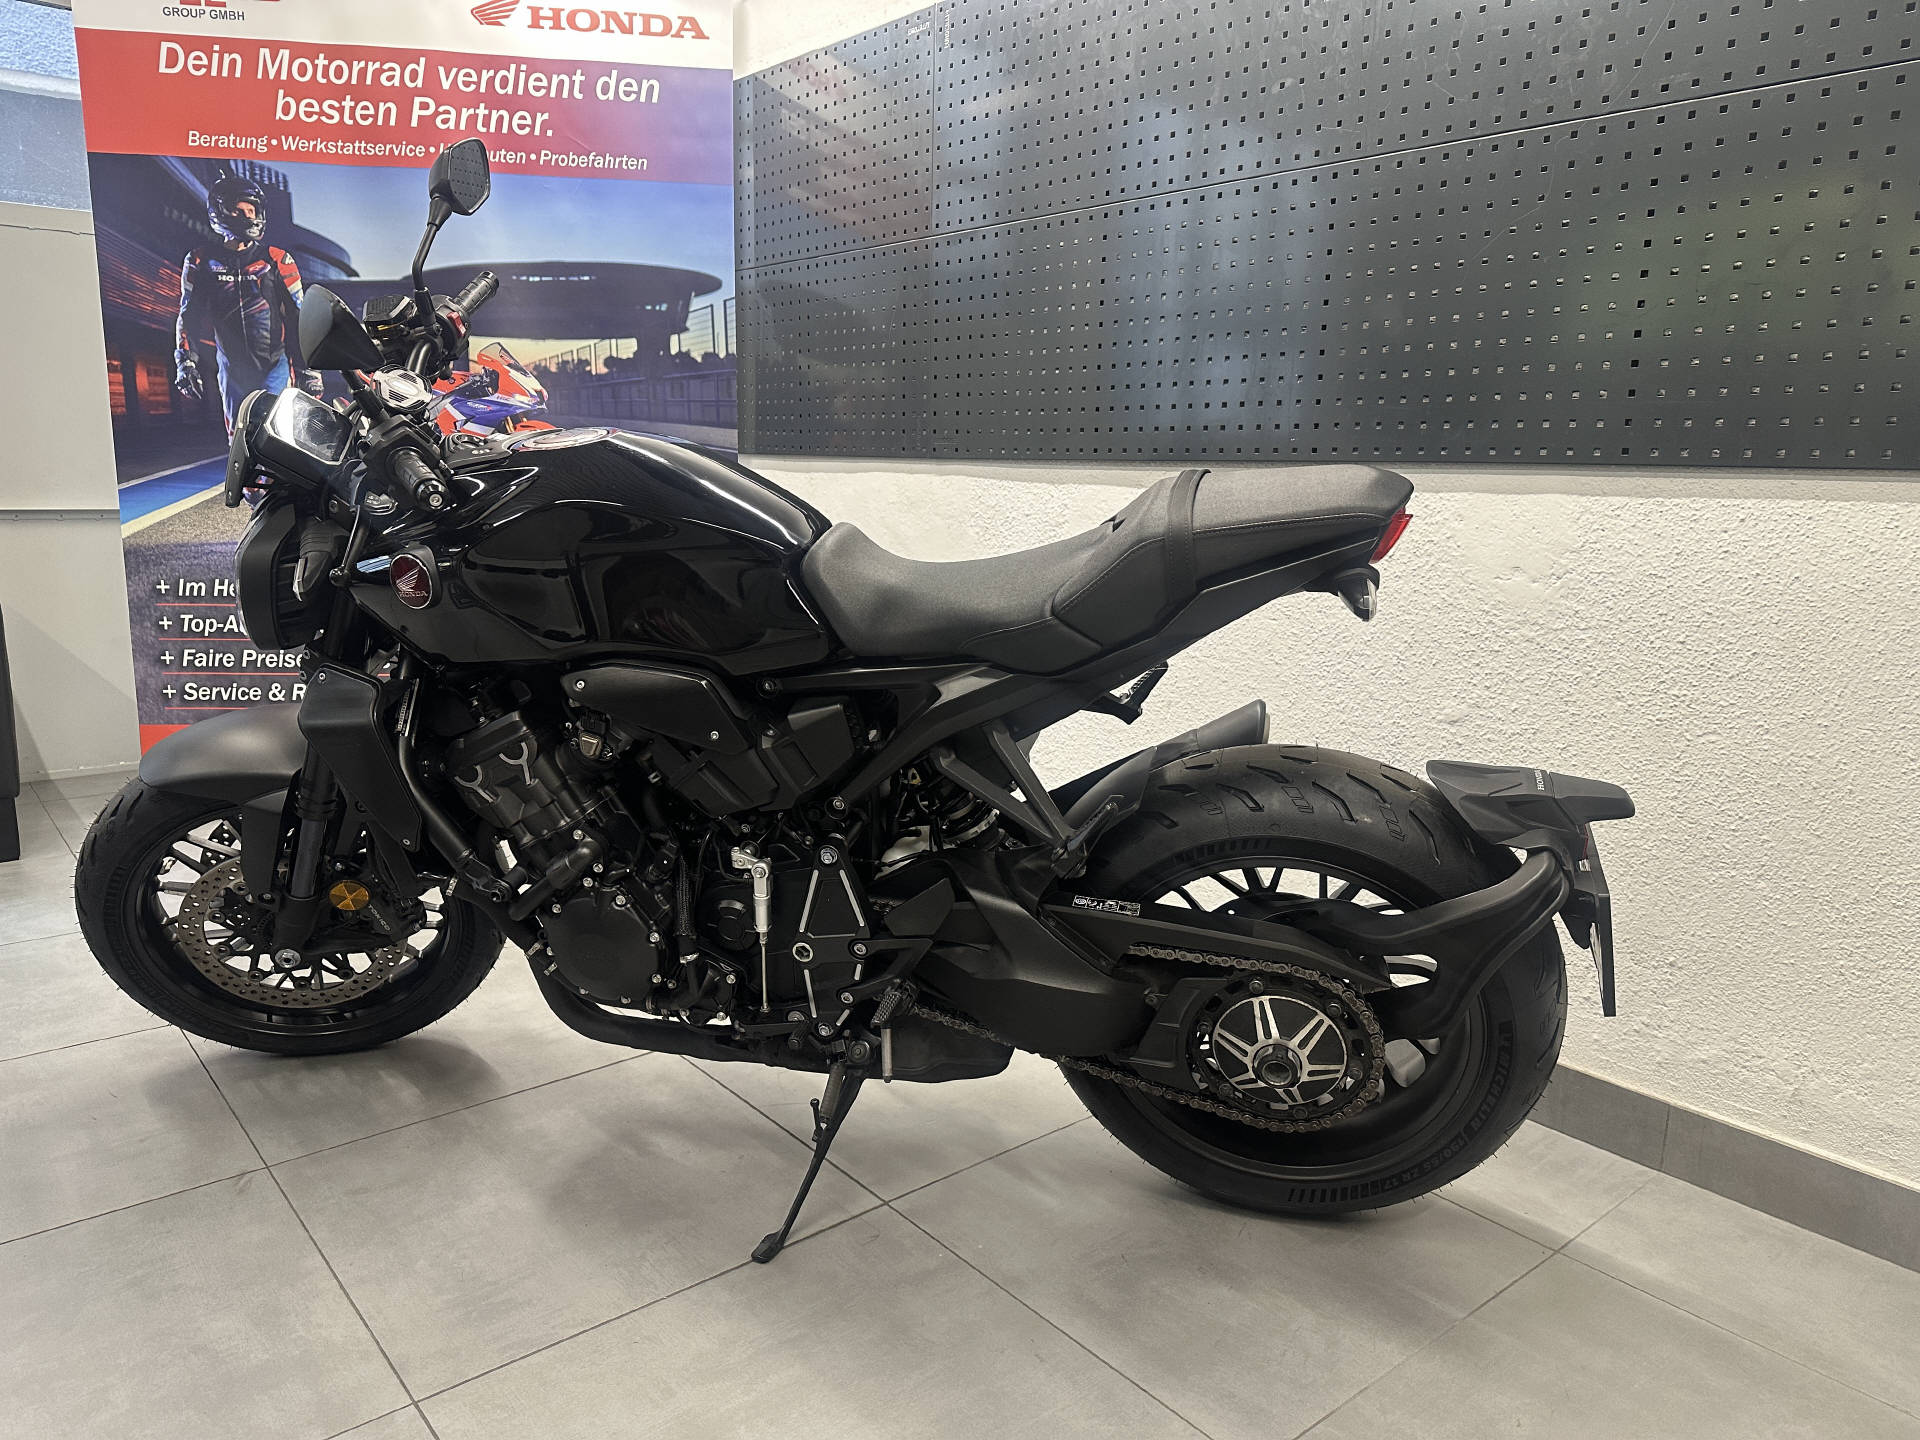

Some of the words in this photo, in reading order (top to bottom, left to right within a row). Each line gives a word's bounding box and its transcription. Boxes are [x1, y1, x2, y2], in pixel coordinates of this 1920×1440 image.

[162, 6, 206, 19] GROUP
[209, 9, 245, 21] GMBH
[527, 5, 710, 40] HONDA
[158, 41, 242, 78] Dein
[256, 47, 426, 88] Motorrad
[437, 63, 586, 100] verdient
[595, 69, 660, 104] den
[275, 89, 398, 127] besten
[410, 96, 553, 137] Partner.
[187, 130, 268, 153] Beratung
[281, 135, 426, 157] Werkstattservice
[539, 150, 648, 170] Probefahrten
[178, 578, 206, 597] Im
[182, 649, 235, 668] Faire
[183, 682, 262, 701] Service
[268, 682, 286, 701] &
[368, 904, 391, 931] TOKICO
